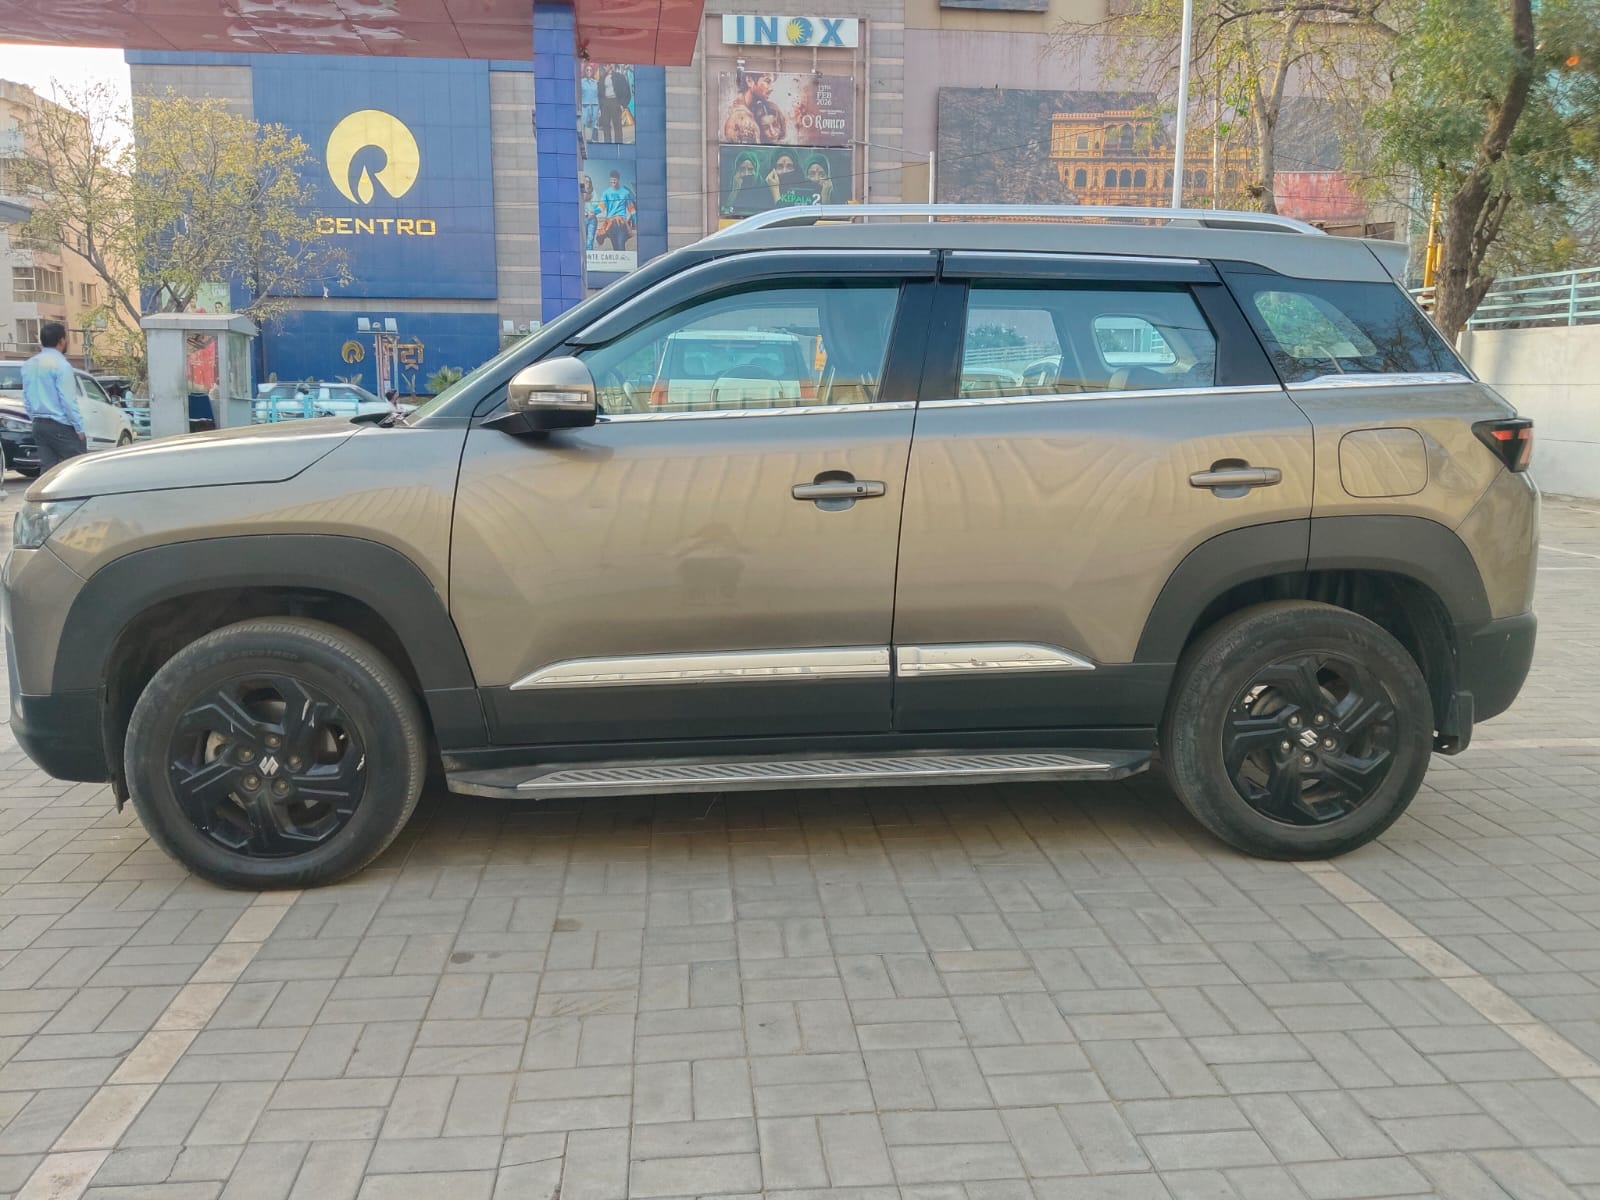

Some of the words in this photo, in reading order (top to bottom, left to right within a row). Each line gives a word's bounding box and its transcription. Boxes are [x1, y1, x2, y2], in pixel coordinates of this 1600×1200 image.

[736, 15, 845, 46] INOX
[812, 193, 821, 206] 2
[316, 217, 437, 236] CENTRO
